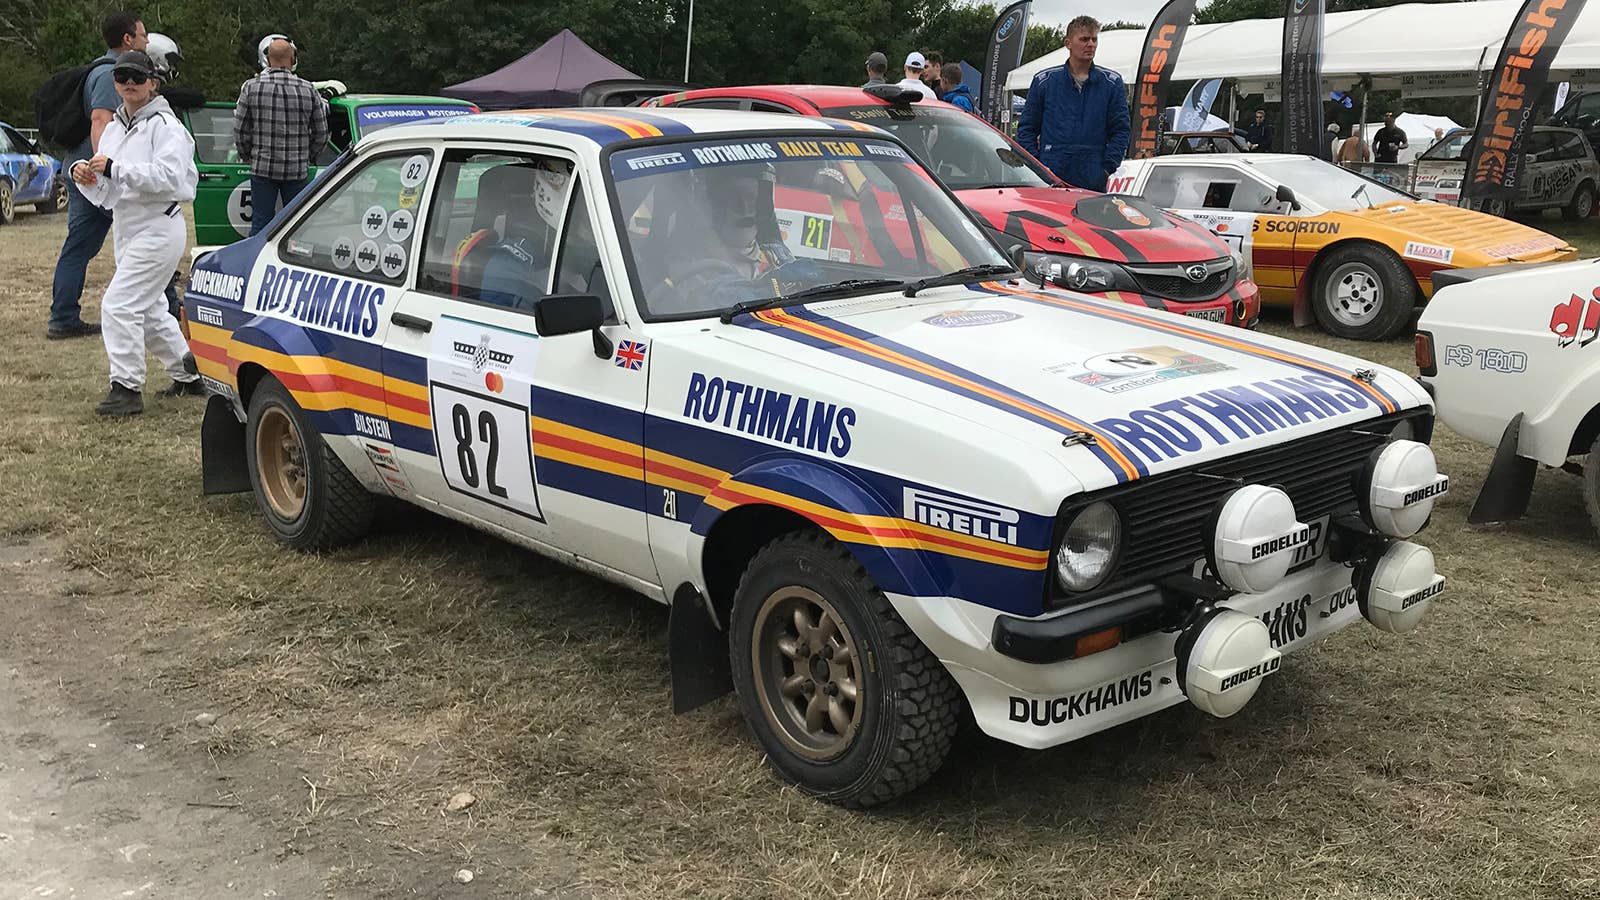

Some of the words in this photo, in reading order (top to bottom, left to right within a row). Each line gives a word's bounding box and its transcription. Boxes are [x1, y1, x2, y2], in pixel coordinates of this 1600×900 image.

[364, 110, 425, 119] VOLKSWAGEN
[849, 108, 891, 119] Shelly
[626, 152, 686, 170] PIRELLI
[692, 143, 777, 165] ROTHMANS
[777, 141, 824, 157] RALLY
[821, 141, 864, 157] TEAM
[1504, 151, 1519, 187] RALLY
[1513, 101, 1534, 149] SCHOOL
[407, 164, 421, 179] 82
[805, 217, 825, 249] 21
[1266, 220, 1341, 234] SCORTON
[1414, 245, 1444, 257] LEDA
[191, 269, 245, 302] DUCKHAMS
[197, 305, 223, 326] PIRELLI
[256, 264, 385, 339] ROTHMANS
[1445, 344, 1473, 367] RS
[1099, 374, 1168, 394] Lombard
[354, 413, 392, 440] BILSTEIN
[683, 372, 856, 458] ROTHMANS
[1092, 374, 1370, 463] ROTHMANS
[453, 403, 508, 500] 82
[1404, 479, 1448, 506] CARELLO
[903, 486, 1020, 545] PIRELLI
[1252, 528, 1308, 560] CARELLO
[1401, 580, 1445, 610] CARELLO
[1221, 655, 1281, 692] CARELLO
[1008, 670, 1153, 727] DUCKHAMS
